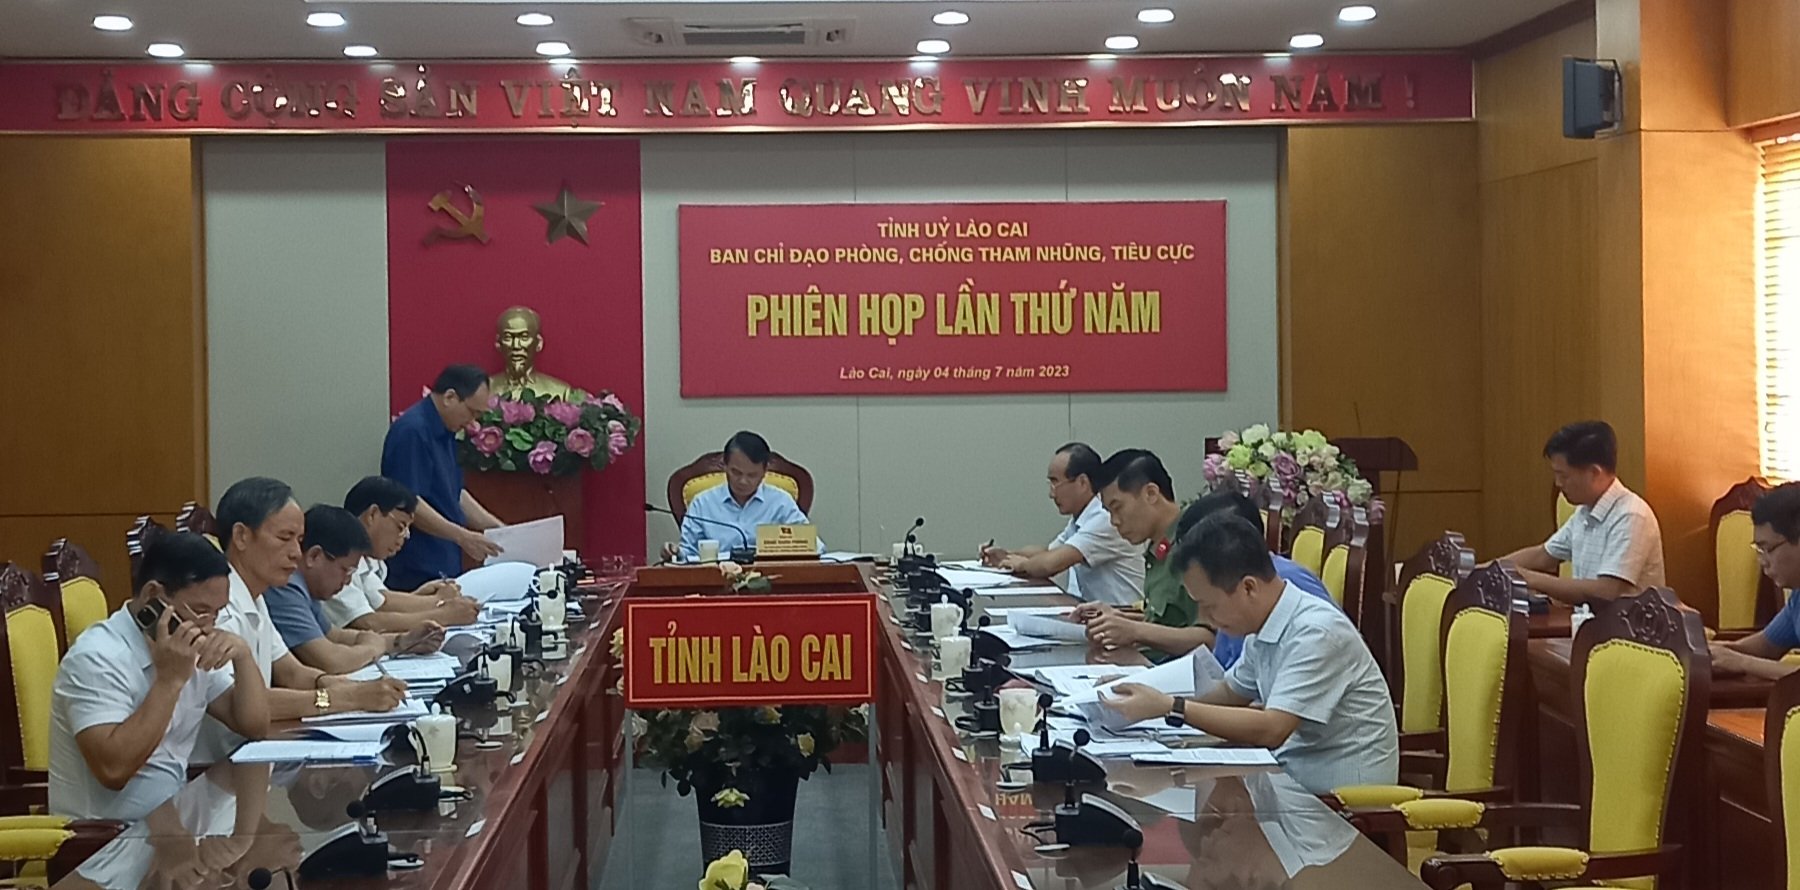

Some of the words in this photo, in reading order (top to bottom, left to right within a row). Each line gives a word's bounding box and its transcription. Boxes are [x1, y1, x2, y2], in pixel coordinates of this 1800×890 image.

[500, 67, 620, 127] VIỆT
[643, 78, 758, 117] NAM
[779, 76, 944, 117] QUANG
[962, 78, 1091, 114] VINH
[877, 216, 920, 239] TỈNH
[925, 216, 951, 238] UỶ
[955, 218, 992, 238] LÀO
[997, 221, 1029, 238] CAI
[709, 247, 749, 264] BAN
[753, 241, 785, 264] CHỈ
[789, 247, 830, 268] ĐẠO
[834, 243, 904, 265] PHÒNG,
[909, 240, 974, 263] CHỐNG
[978, 246, 1031, 262] THAM
[1036, 242, 1107, 263] NHŨNG,
[1111, 241, 1152, 261] TIÊU
[1156, 242, 1196, 264] CỰC
[746, 285, 848, 337] PHIÊN
[858, 292, 925, 346] HỌP
[935, 278, 1000, 336] LẦN
[1009, 279, 1077, 335] THỨ
[1083, 283, 1161, 334] NĂM
[840, 367, 865, 379] Lào
[868, 367, 894, 380] Cai,
[897, 366, 930, 381] ngày
[933, 366, 950, 378] 04
[953, 366, 991, 380] tháng
[995, 366, 1003, 378] 7
[1038, 365, 1070, 377] 2023
[649, 620, 721, 684] TỈNH
[731, 625, 790, 682] LÀO
[801, 634, 852, 681] CAI
